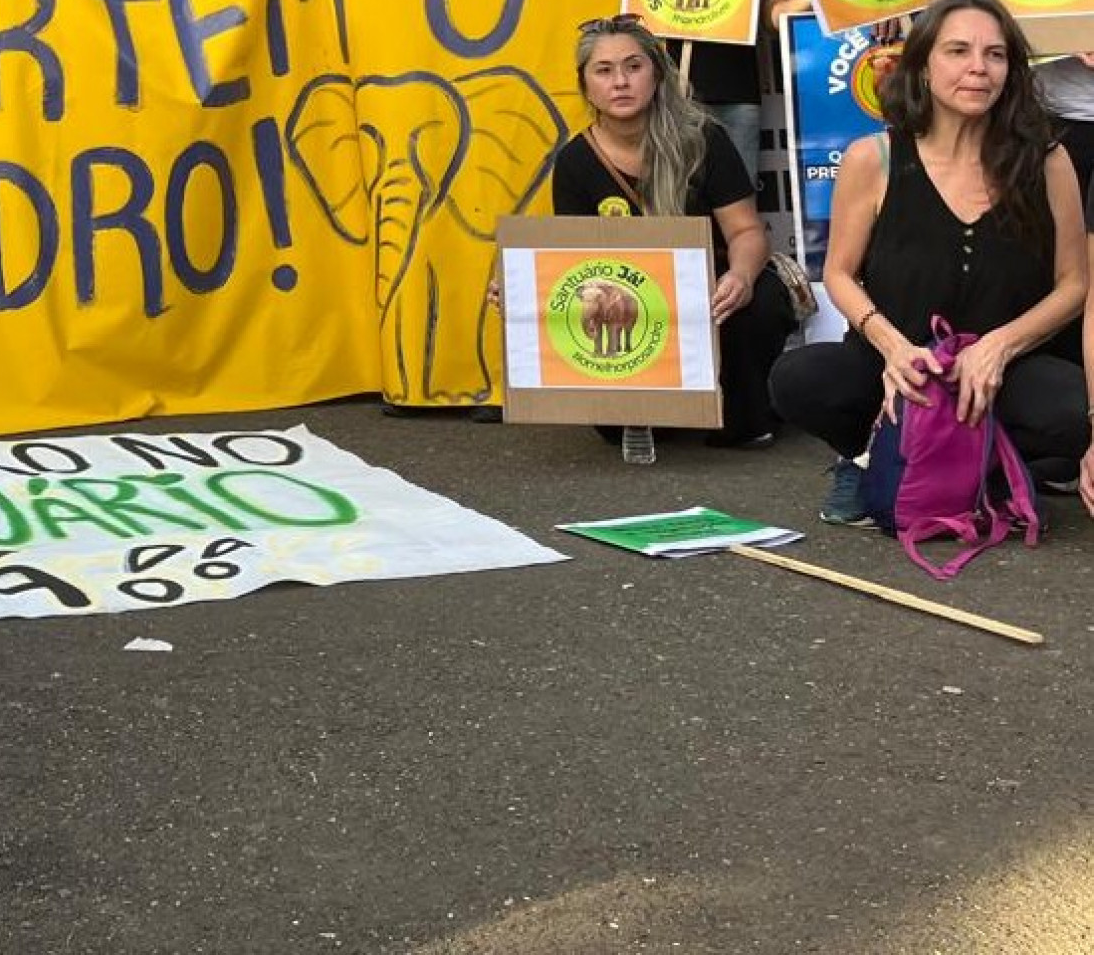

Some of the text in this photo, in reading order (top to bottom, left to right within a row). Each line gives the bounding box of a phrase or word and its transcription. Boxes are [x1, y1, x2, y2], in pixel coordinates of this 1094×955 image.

[549, 261, 646, 313] Santuário Já!
[113, 428, 305, 474] NO
